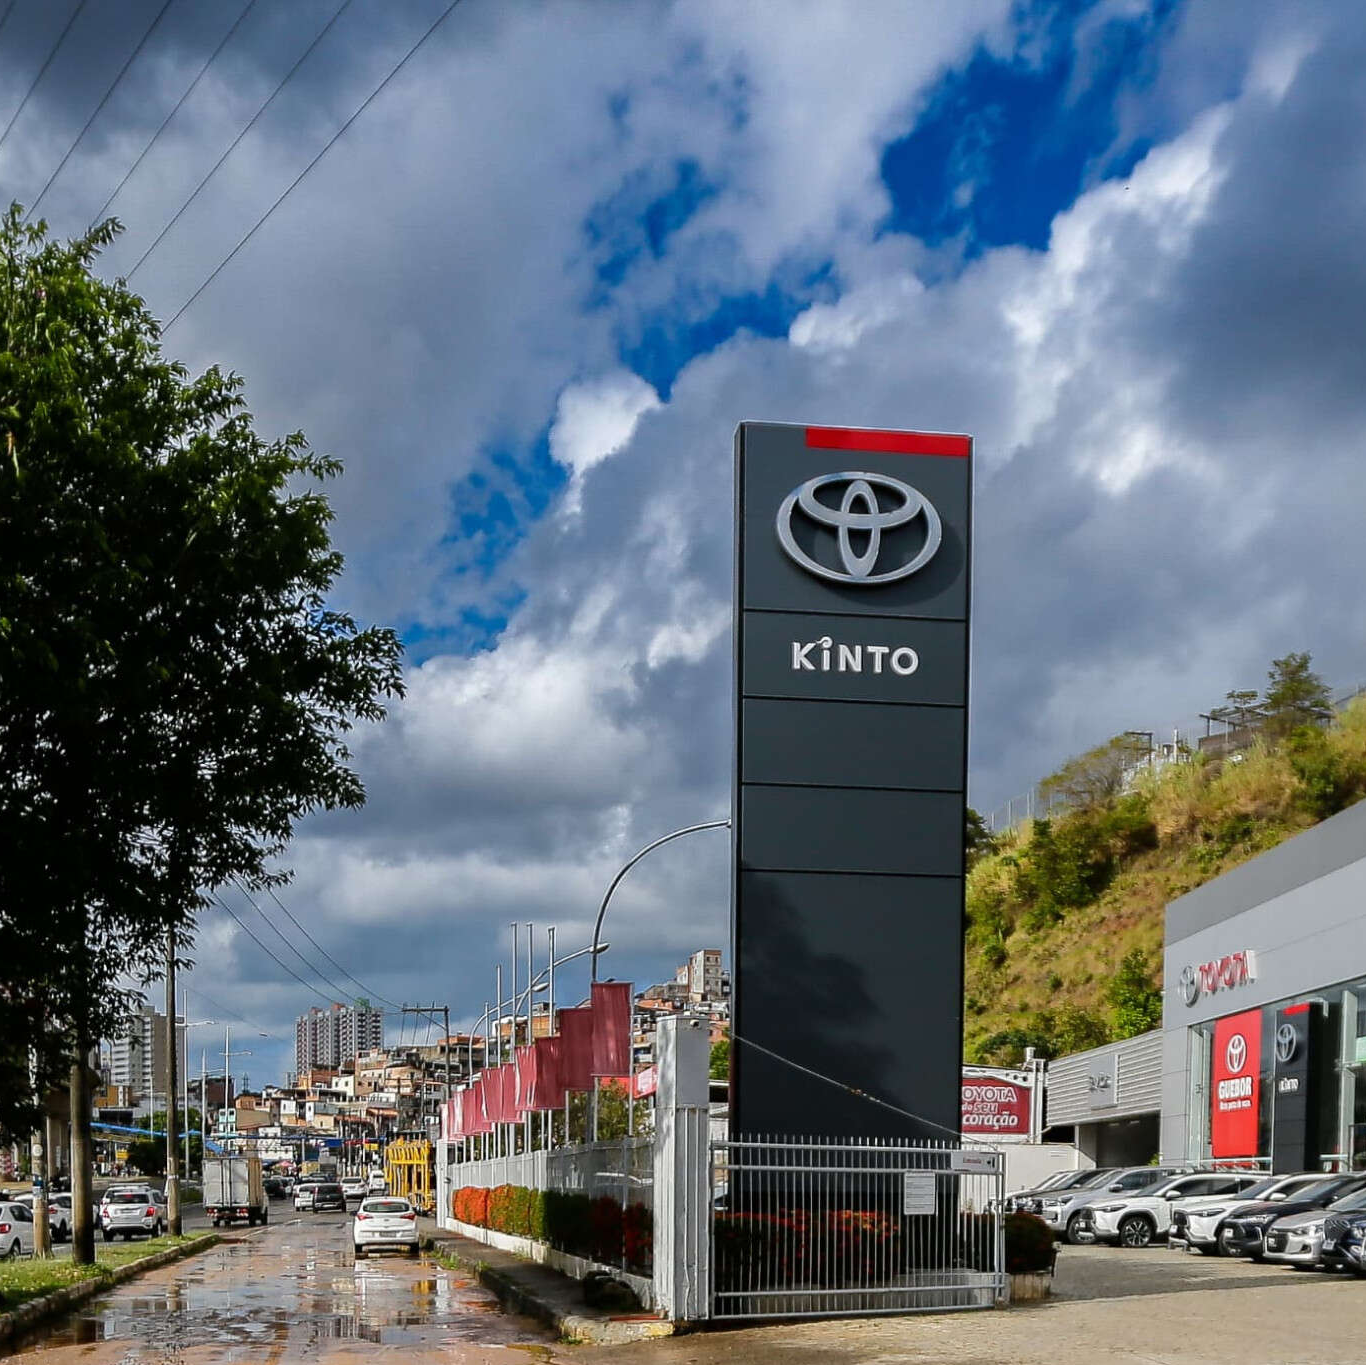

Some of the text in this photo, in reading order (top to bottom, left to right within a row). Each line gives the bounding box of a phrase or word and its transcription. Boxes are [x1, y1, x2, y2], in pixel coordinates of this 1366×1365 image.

[1198, 949, 1257, 992] TOYOTA
[962, 1085, 1018, 1103] OYOTA
[1218, 1076, 1253, 1100] GUEBOR
[973, 1101, 999, 1114] seu
[962, 1111, 1019, 1130] coração
